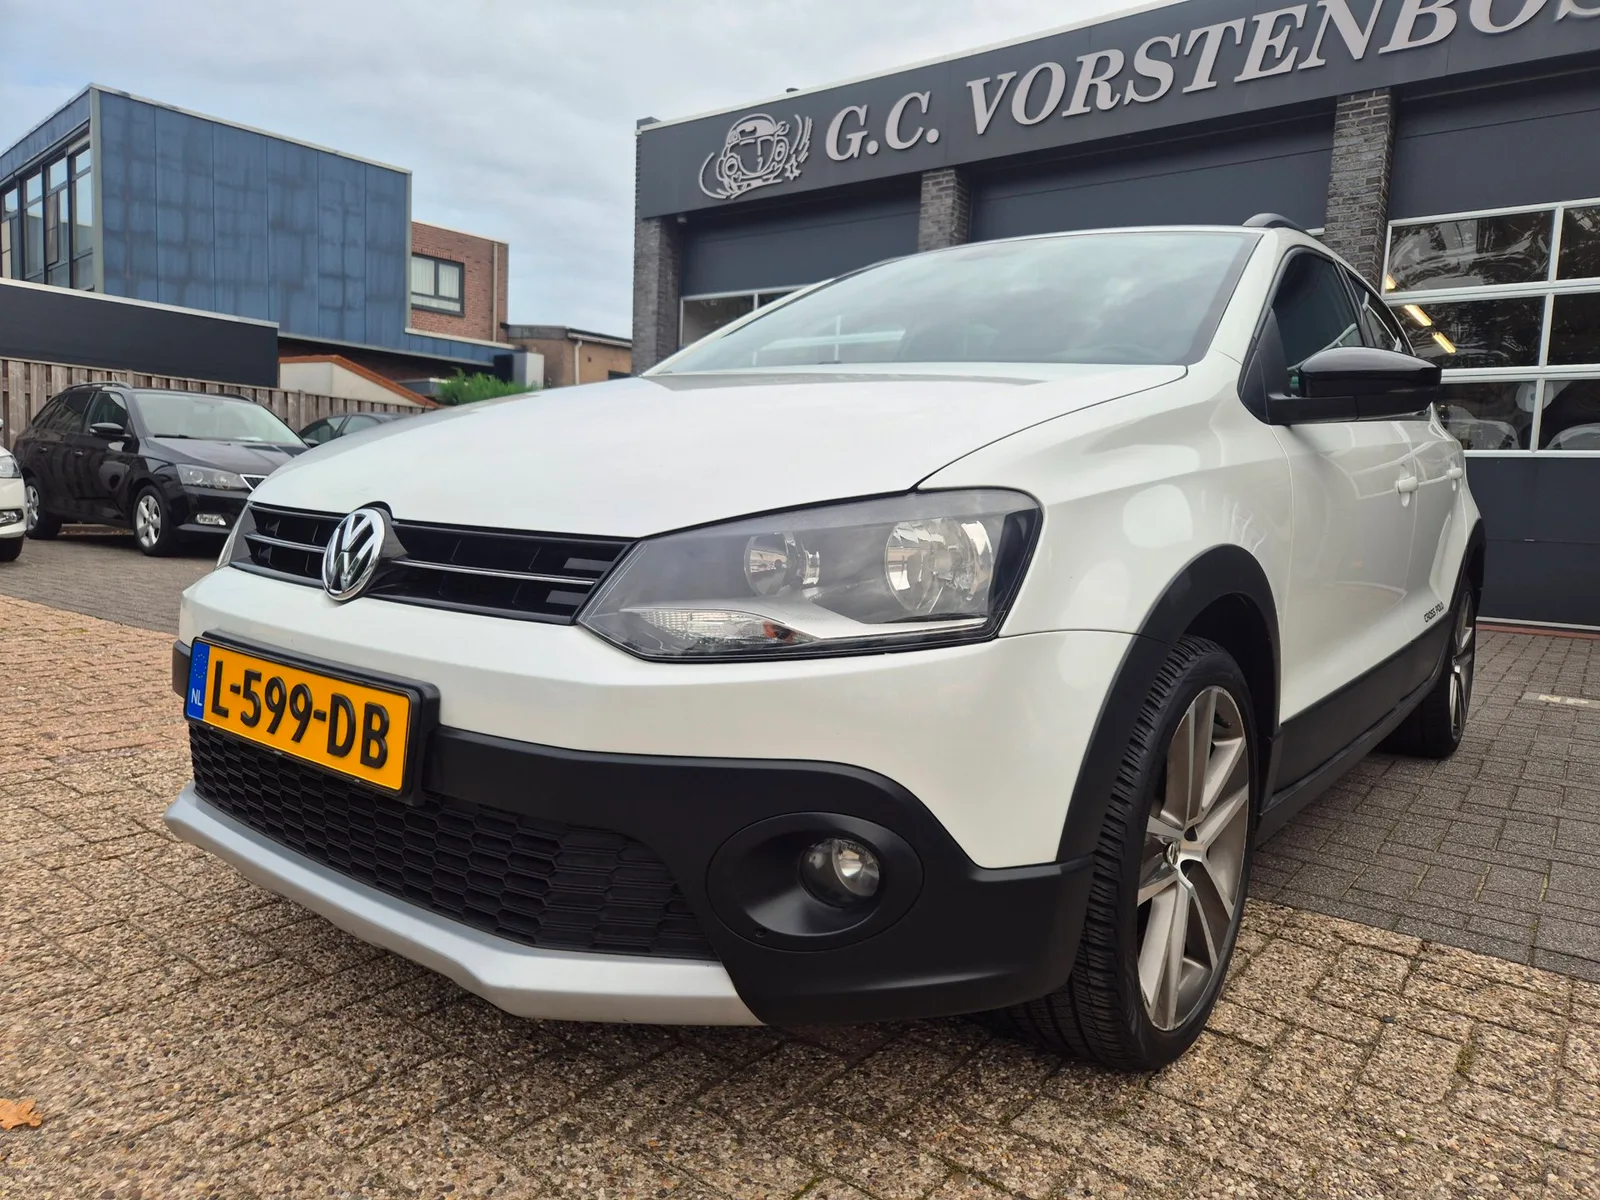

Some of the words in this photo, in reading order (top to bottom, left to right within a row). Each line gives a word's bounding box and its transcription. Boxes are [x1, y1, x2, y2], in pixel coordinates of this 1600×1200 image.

[826, 91, 940, 161] G.C.
[966, 0, 1600, 135] VORSTENBO
[190, 687, 203, 707] NL
[211, 660, 390, 769] L-599-DB
